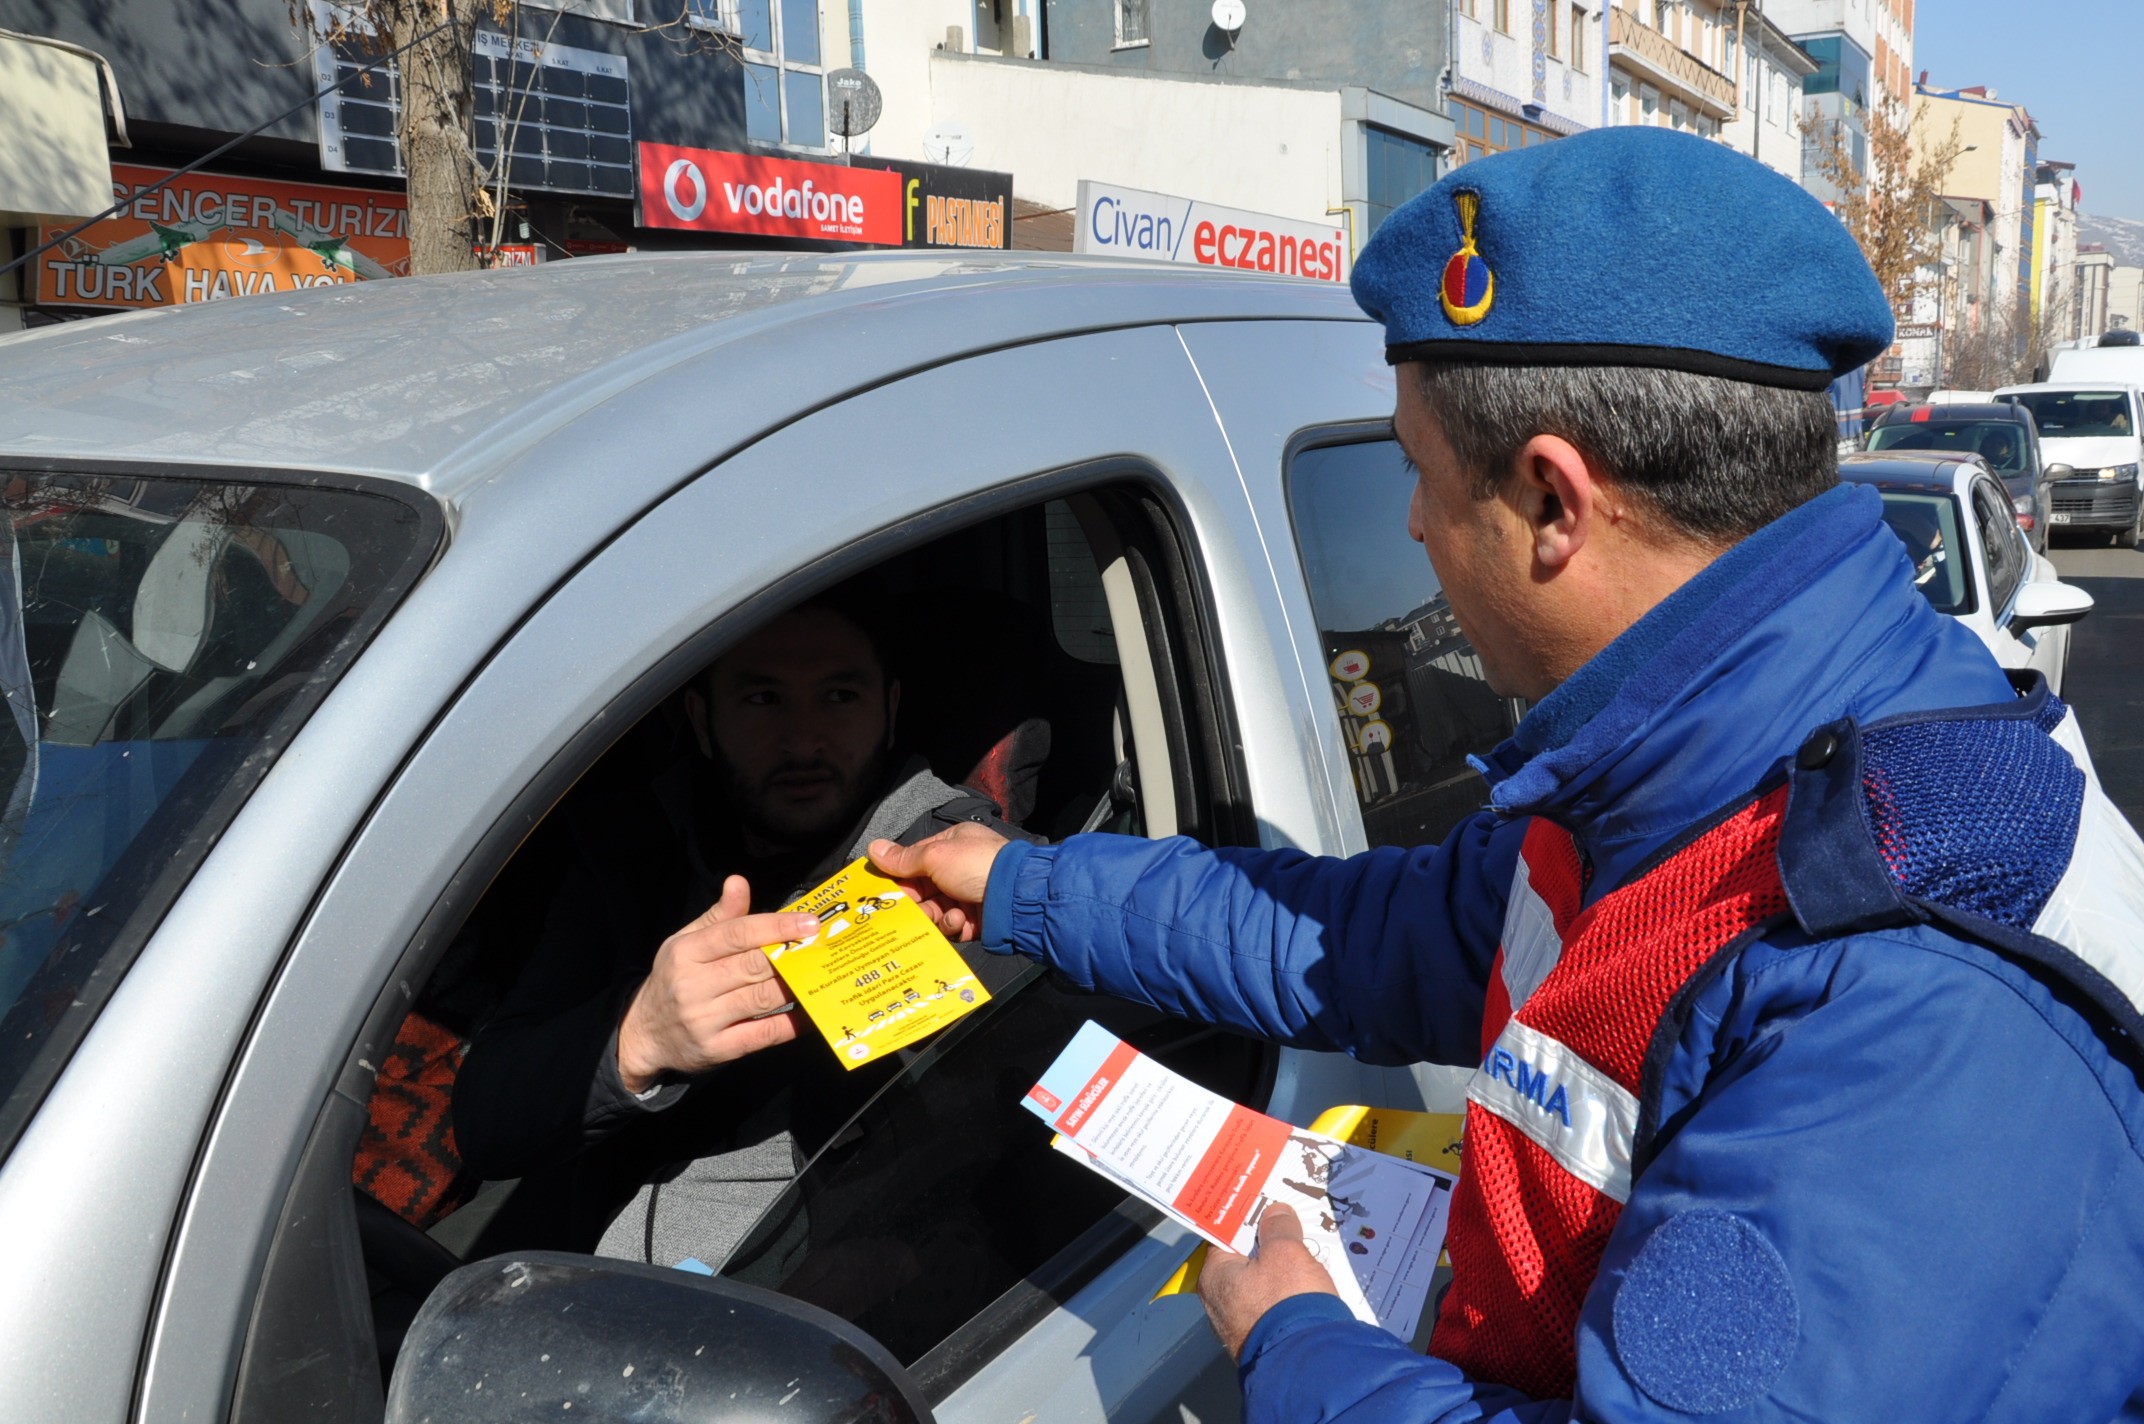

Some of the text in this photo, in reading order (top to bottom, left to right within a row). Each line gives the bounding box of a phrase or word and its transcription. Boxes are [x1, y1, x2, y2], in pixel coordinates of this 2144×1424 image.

[324, 111, 335, 120] D3
[327, 145, 338, 153] D4
[723, 176, 864, 224] vodafone
[926, 194, 1004, 249] PASTANESİ
[1092, 196, 1342, 283] Civan eczanesi
[47, 254, 164, 302] TÜRK
[840, 990, 863, 1006] Trafik
[881, 972, 899, 985] Para
[852, 958, 901, 989] 488 TL
[1076, 1074, 1110, 1111] SÜRÜCÜLER
